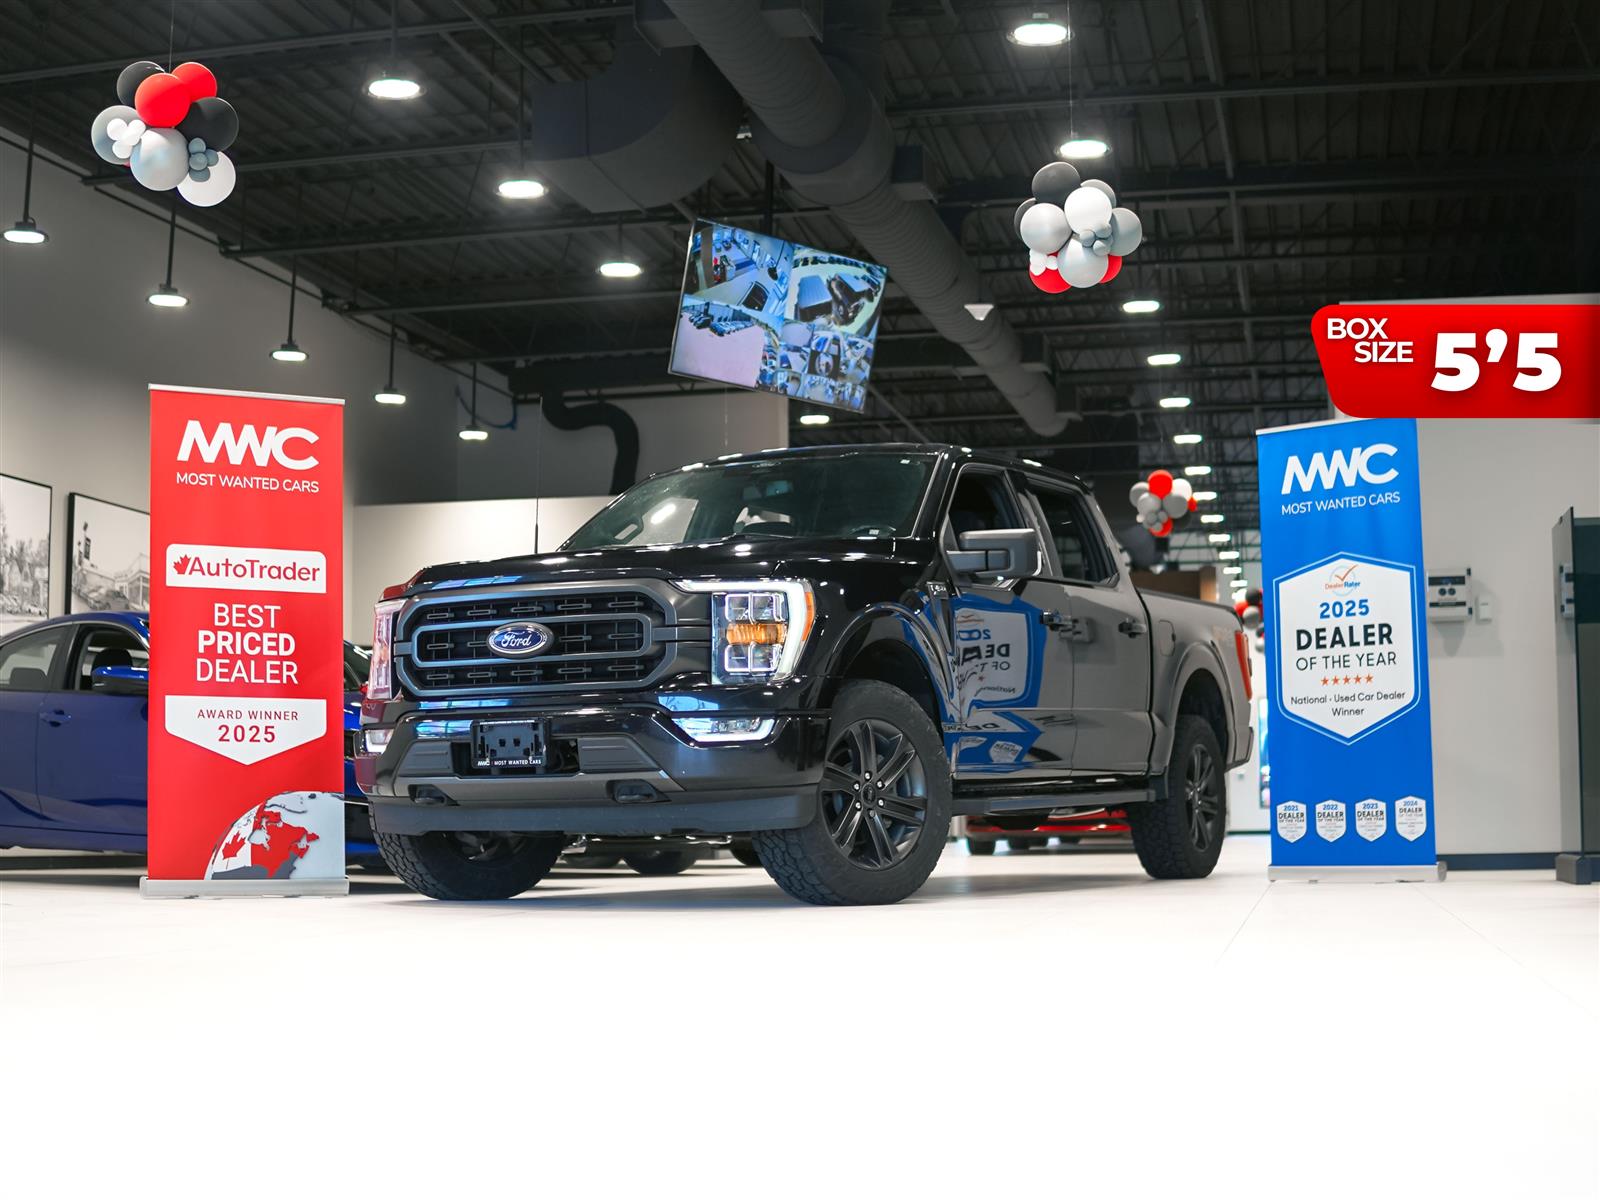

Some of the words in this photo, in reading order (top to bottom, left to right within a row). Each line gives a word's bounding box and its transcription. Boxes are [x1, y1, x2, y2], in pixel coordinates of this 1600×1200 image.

[176, 419, 320, 470] MWC
[1281, 443, 1399, 495] MWC
[176, 472, 216, 486] MOST
[219, 474, 280, 491] WANTED
[283, 479, 319, 493] CARS
[1281, 501, 1313, 515] MOST
[1315, 496, 1367, 512] WANTED
[1369, 491, 1400, 506] CARS
[188, 556, 320, 581] AutoTrader
[1324, 581, 1361, 590] DealerRater
[213, 602, 281, 629] BEST
[1319, 599, 1370, 619] 2025
[198, 630, 296, 656] PRICED
[501, 631, 532, 647] Ford
[1296, 622, 1393, 651] DEALER
[1296, 657, 1317, 671] OF
[1322, 654, 1351, 670] THE
[1355, 651, 1397, 667] YEAR
[196, 658, 299, 685] DEALER
[1290, 694, 1328, 705] National
[1333, 693, 1356, 703] Used
[1357, 692, 1375, 702] Car
[1376, 691, 1406, 701] Dealer
[197, 708, 243, 720] AWARD
[247, 709, 299, 721] WINNER
[1331, 708, 1365, 717] Winner
[217, 724, 276, 743] 2025
[1278, 812, 1305, 820] DEALER
[1317, 811, 1344, 819] DEALER
[1322, 803, 1338, 811] 2022
[1357, 810, 1384, 818] DEALER
